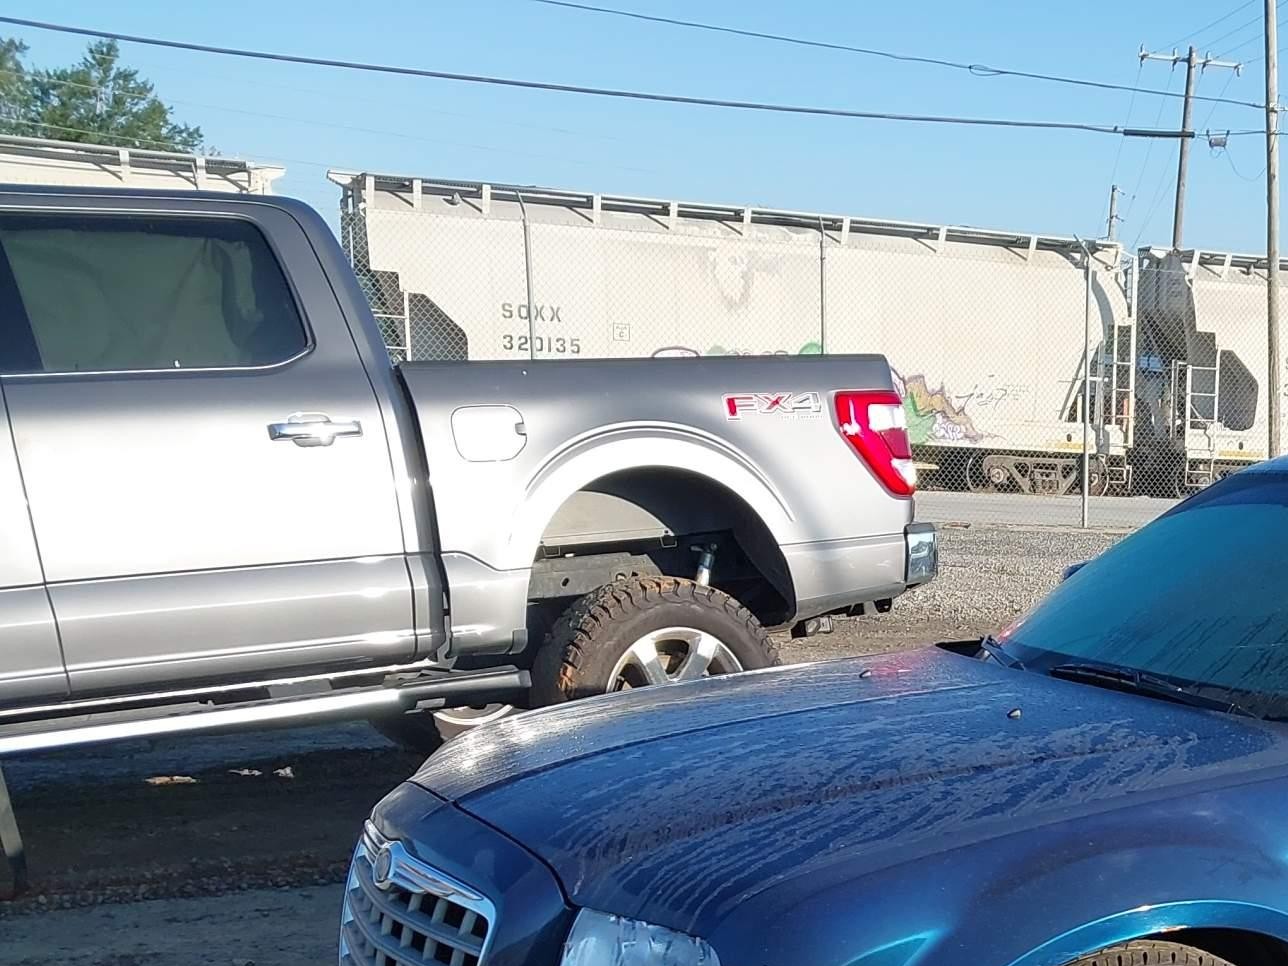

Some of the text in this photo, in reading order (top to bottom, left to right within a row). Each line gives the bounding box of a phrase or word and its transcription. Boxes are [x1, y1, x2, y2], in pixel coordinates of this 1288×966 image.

[501, 303, 562, 322] SOXX
[502, 335, 581, 354] 320135
[722, 392, 822, 421] FX4
